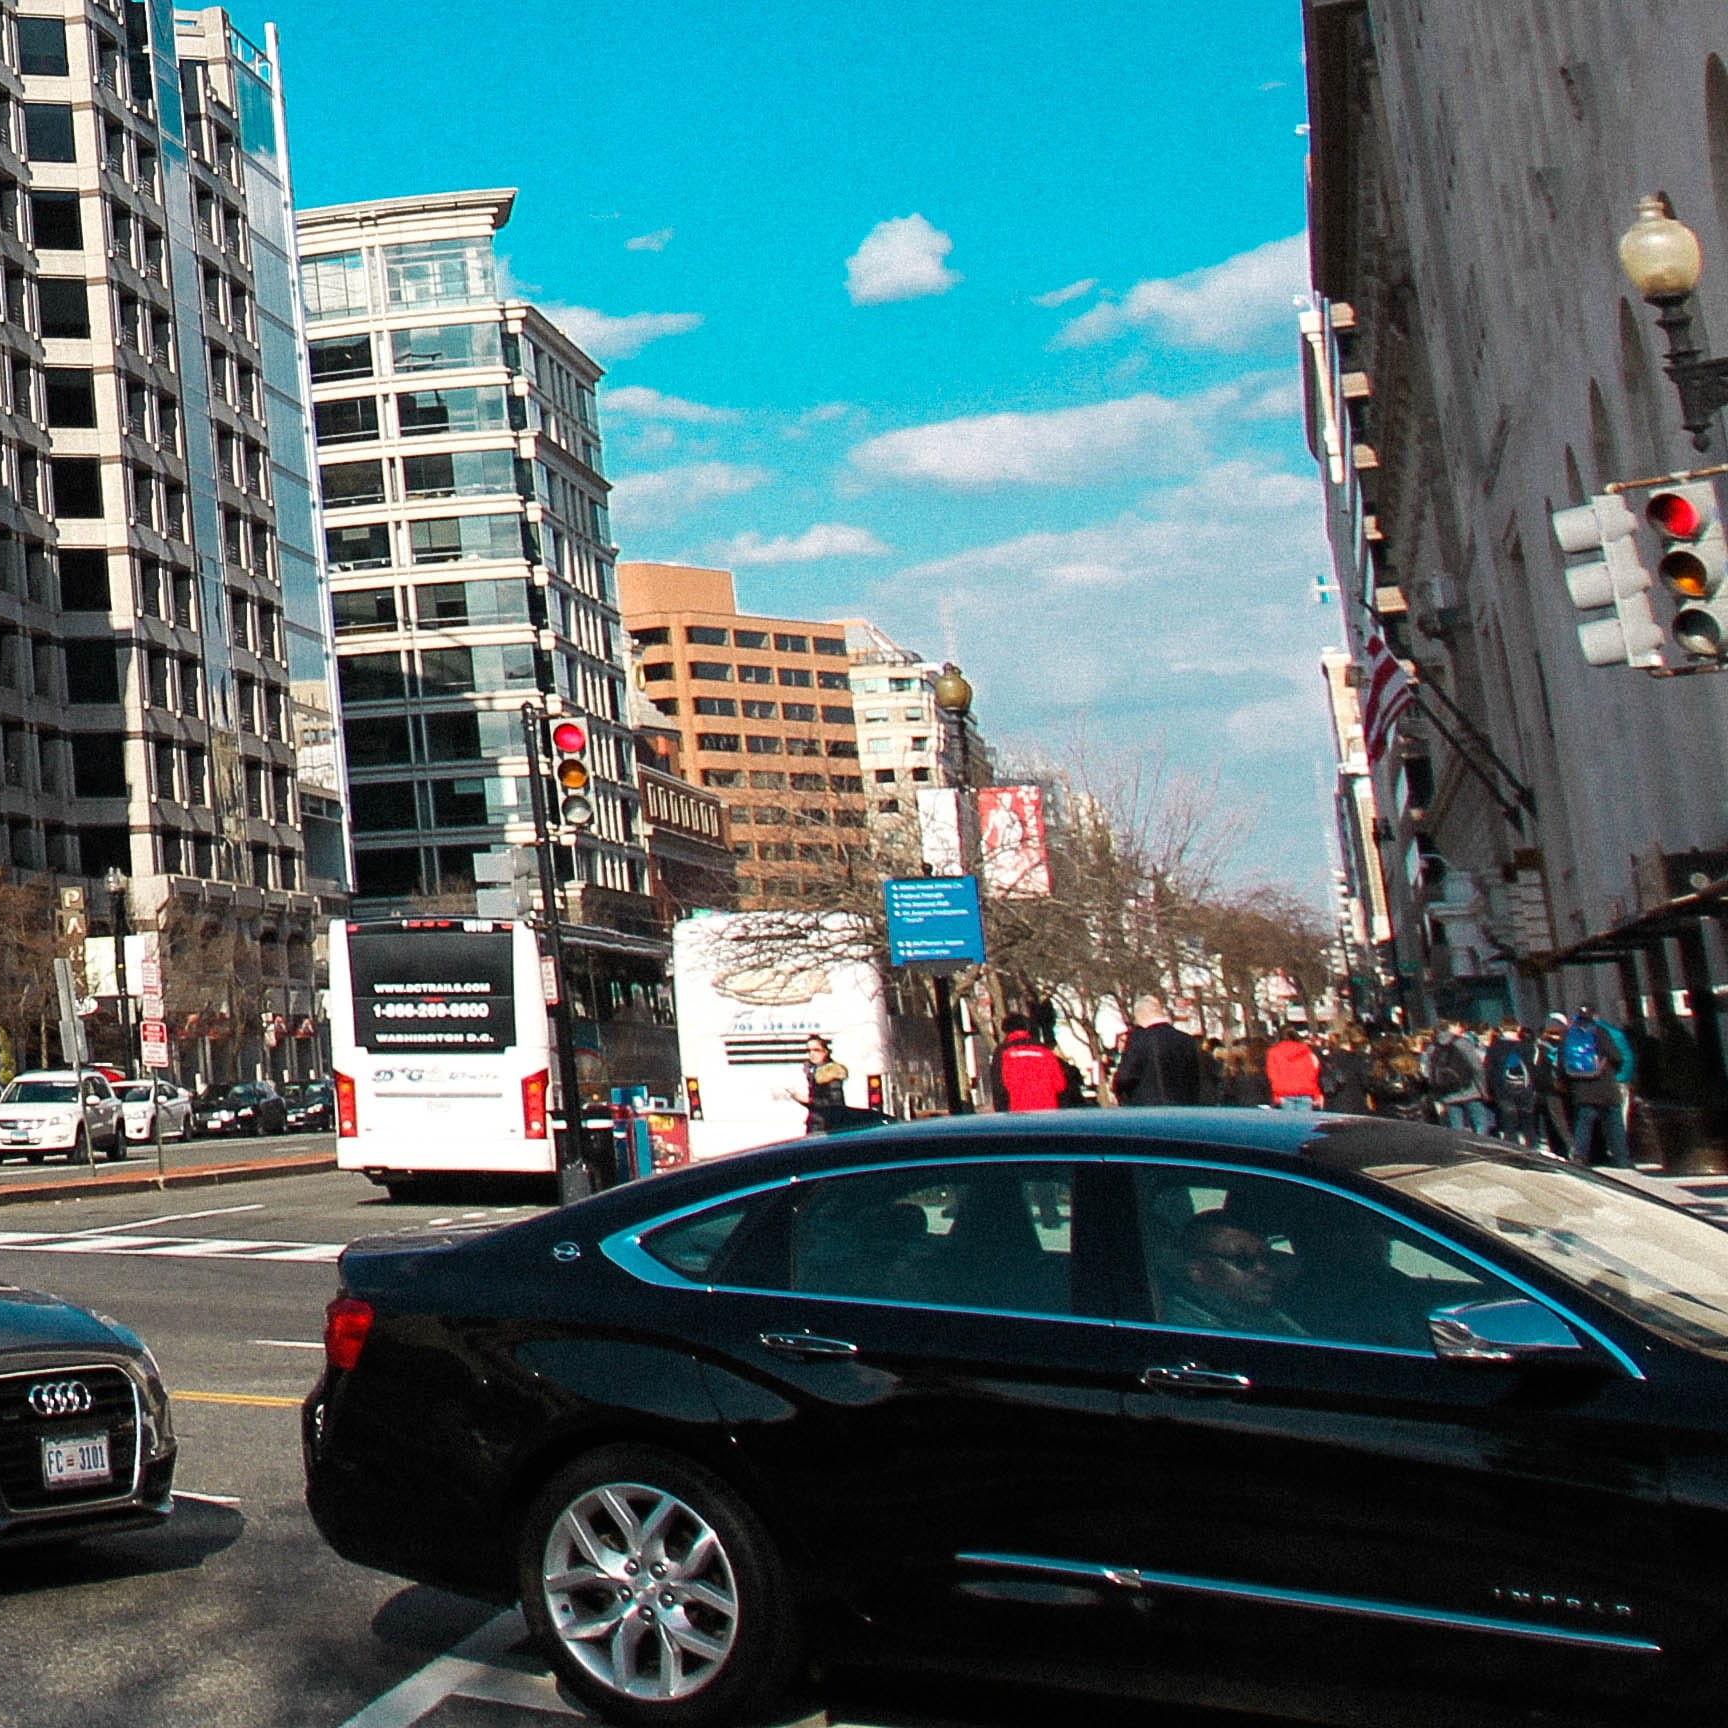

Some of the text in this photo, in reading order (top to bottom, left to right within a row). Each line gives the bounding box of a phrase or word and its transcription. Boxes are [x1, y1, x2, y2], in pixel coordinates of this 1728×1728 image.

[376, 1034, 464, 1042] WASHINGTON
[47, 1446, 106, 1474] FC 3101
